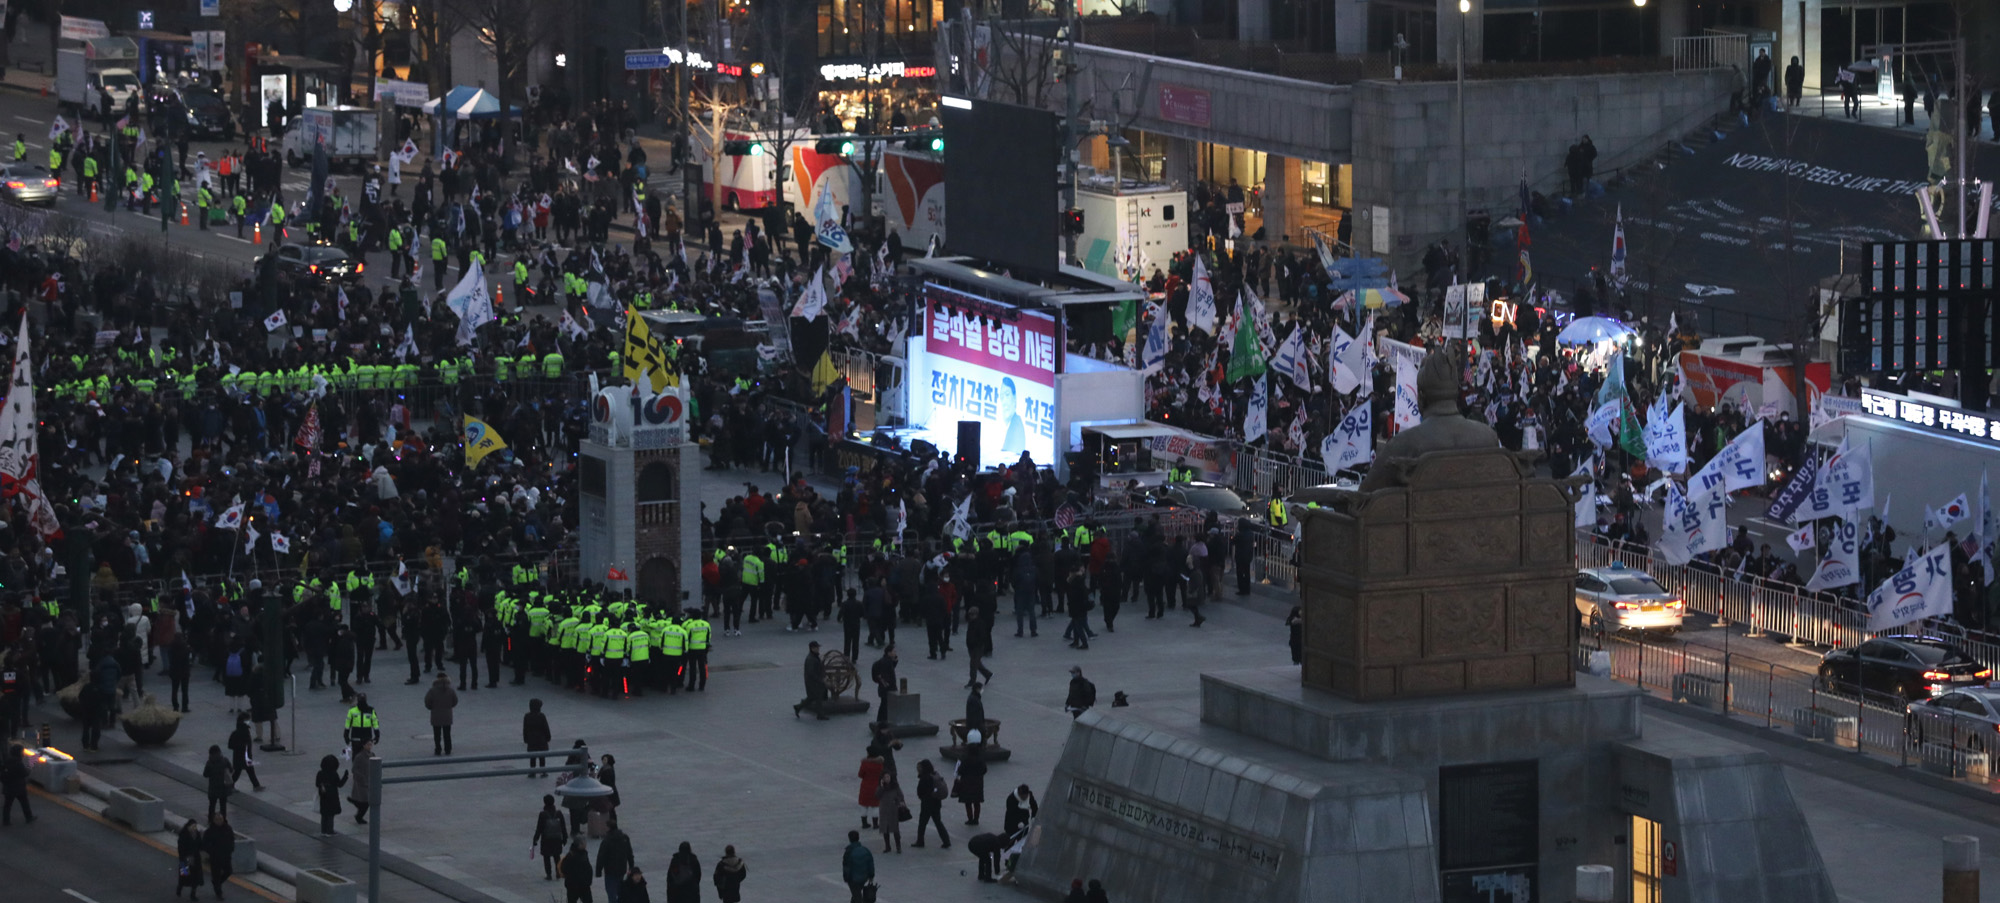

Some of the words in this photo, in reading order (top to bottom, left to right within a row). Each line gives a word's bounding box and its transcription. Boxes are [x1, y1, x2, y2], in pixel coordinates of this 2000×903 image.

[1722, 152, 1807, 177] NOTHING
[1800, 165, 1852, 187] FEELS
[1843, 175, 1890, 193] LIKE
[1141, 207, 1151, 217] kt
[933, 306, 983, 352] 윤석열
[987, 318, 1021, 362] 당장
[931, 369, 1000, 421] 정치검찰
[1025, 396, 1055, 439] 척결
